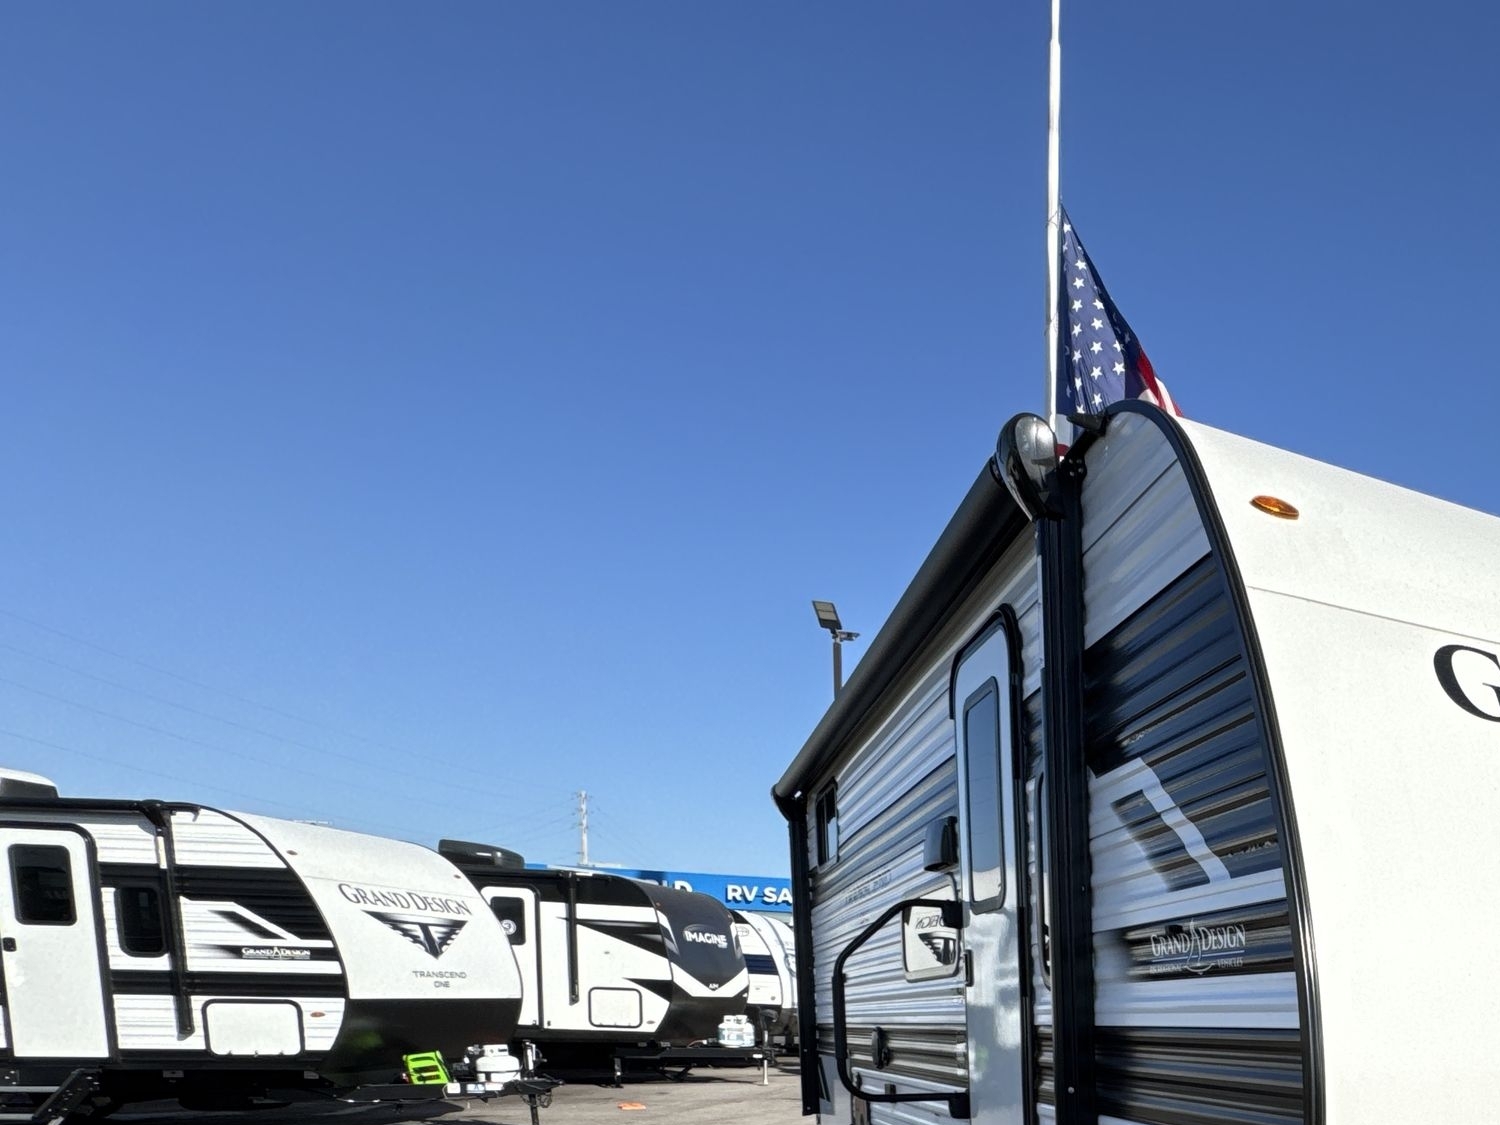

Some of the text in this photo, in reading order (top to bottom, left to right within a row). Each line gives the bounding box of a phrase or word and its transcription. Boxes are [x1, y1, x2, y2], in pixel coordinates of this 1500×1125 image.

[338, 883, 472, 915] GRAND DESIGN
[727, 884, 758, 901] RV
[684, 930, 727, 944] IMAGINE
[1150, 923, 1246, 957] GRAND DESIGN
[412, 970, 467, 979] TRANSCEND
